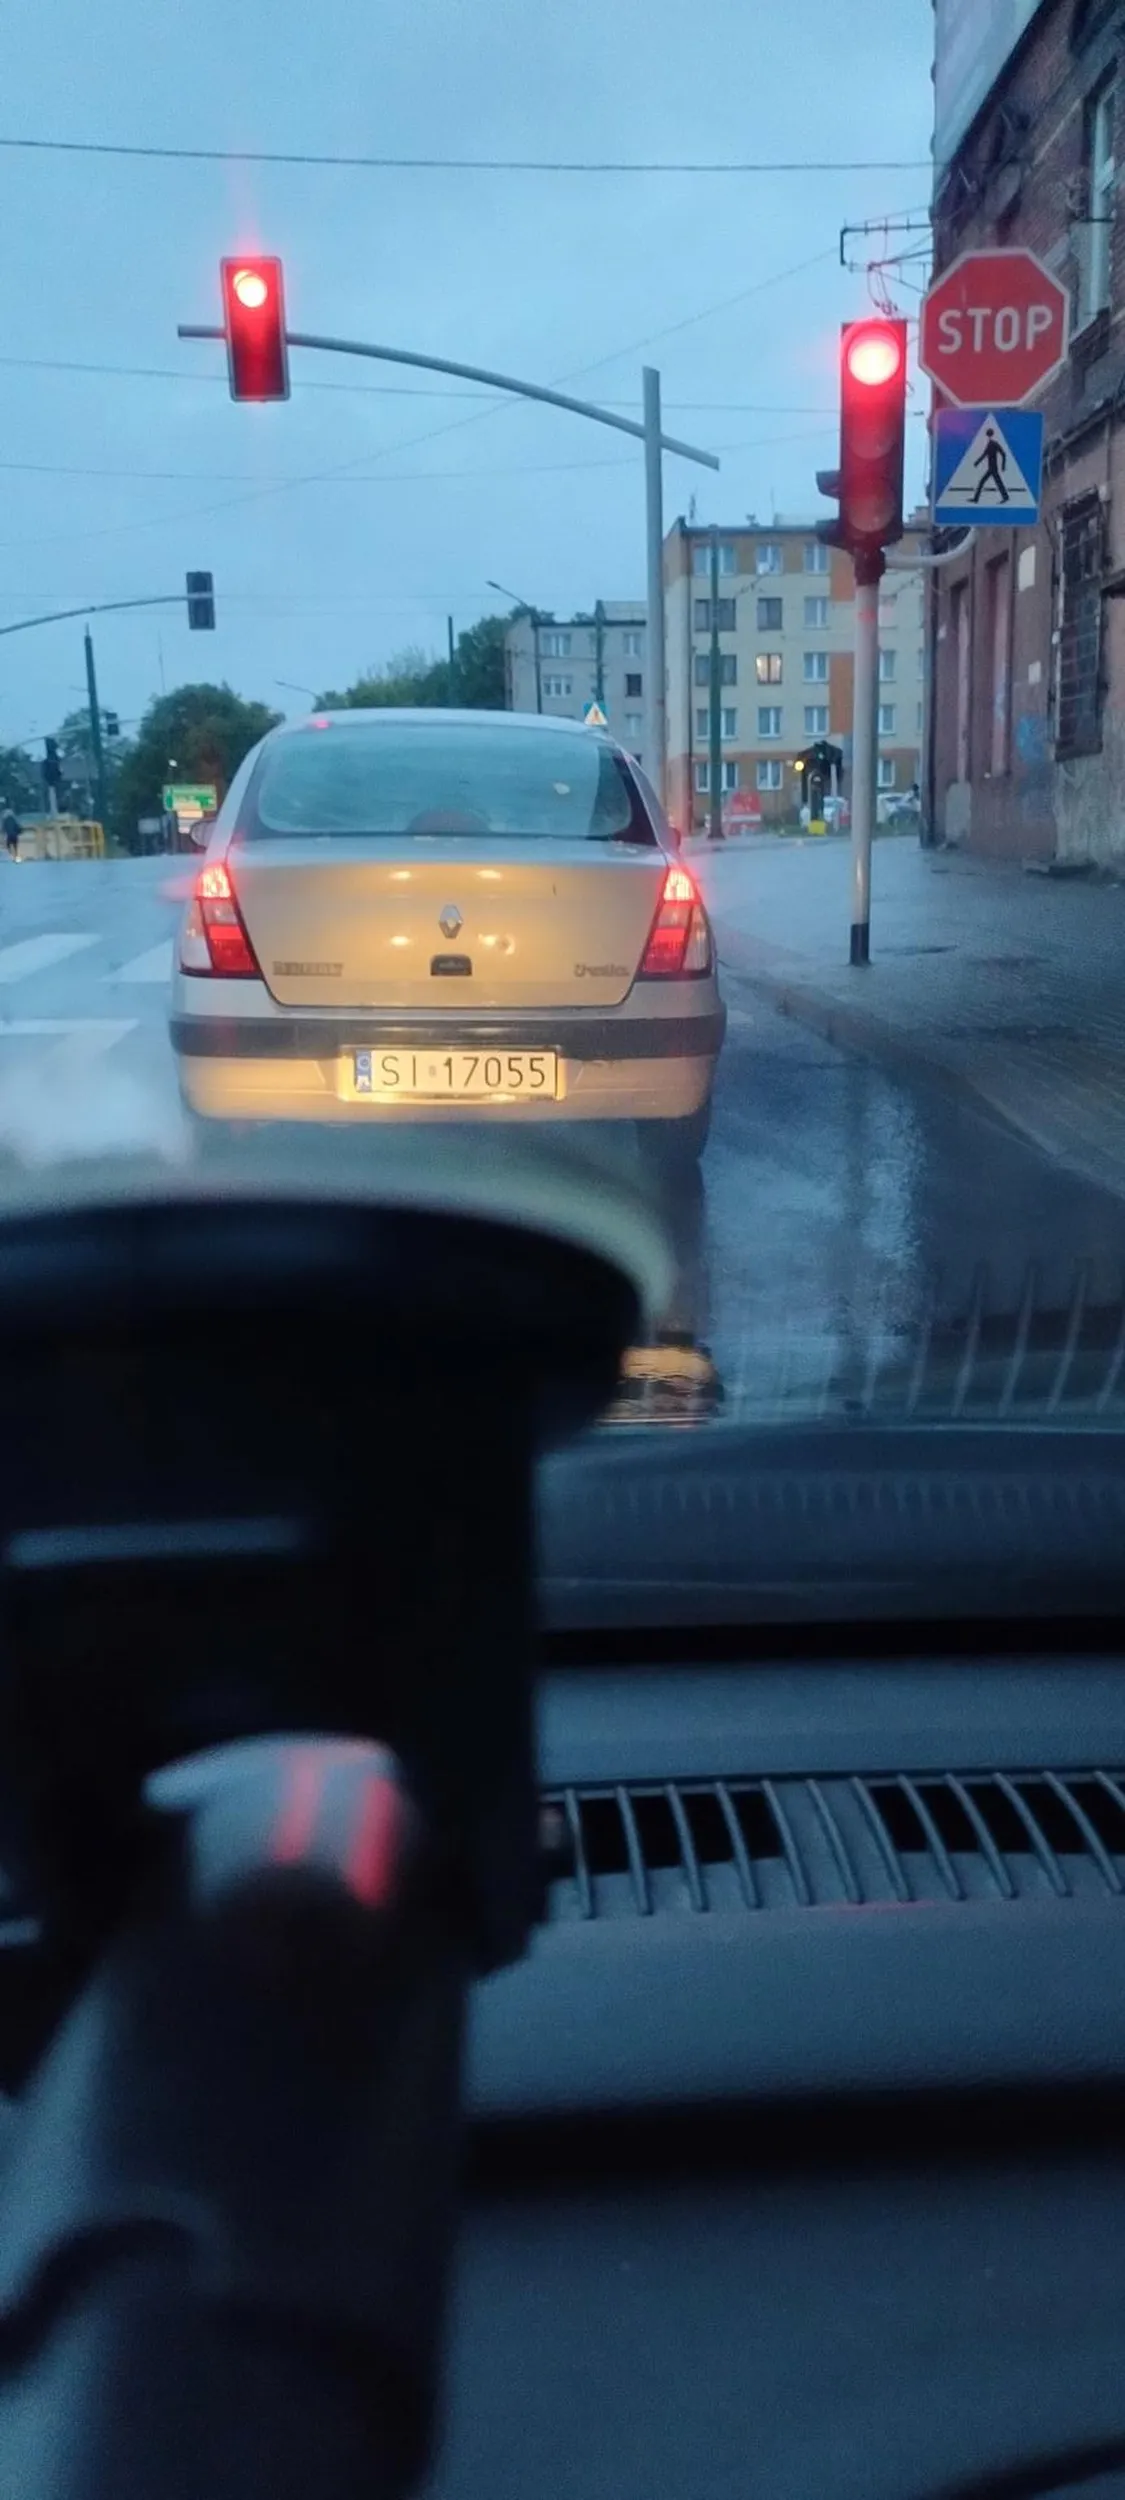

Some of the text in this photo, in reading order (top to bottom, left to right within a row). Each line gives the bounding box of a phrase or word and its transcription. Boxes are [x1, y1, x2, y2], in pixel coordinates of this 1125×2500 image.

[938, 305, 1053, 354] STOP
[381, 1055, 417, 1087] SI
[443, 1057, 545, 1088] 17055
